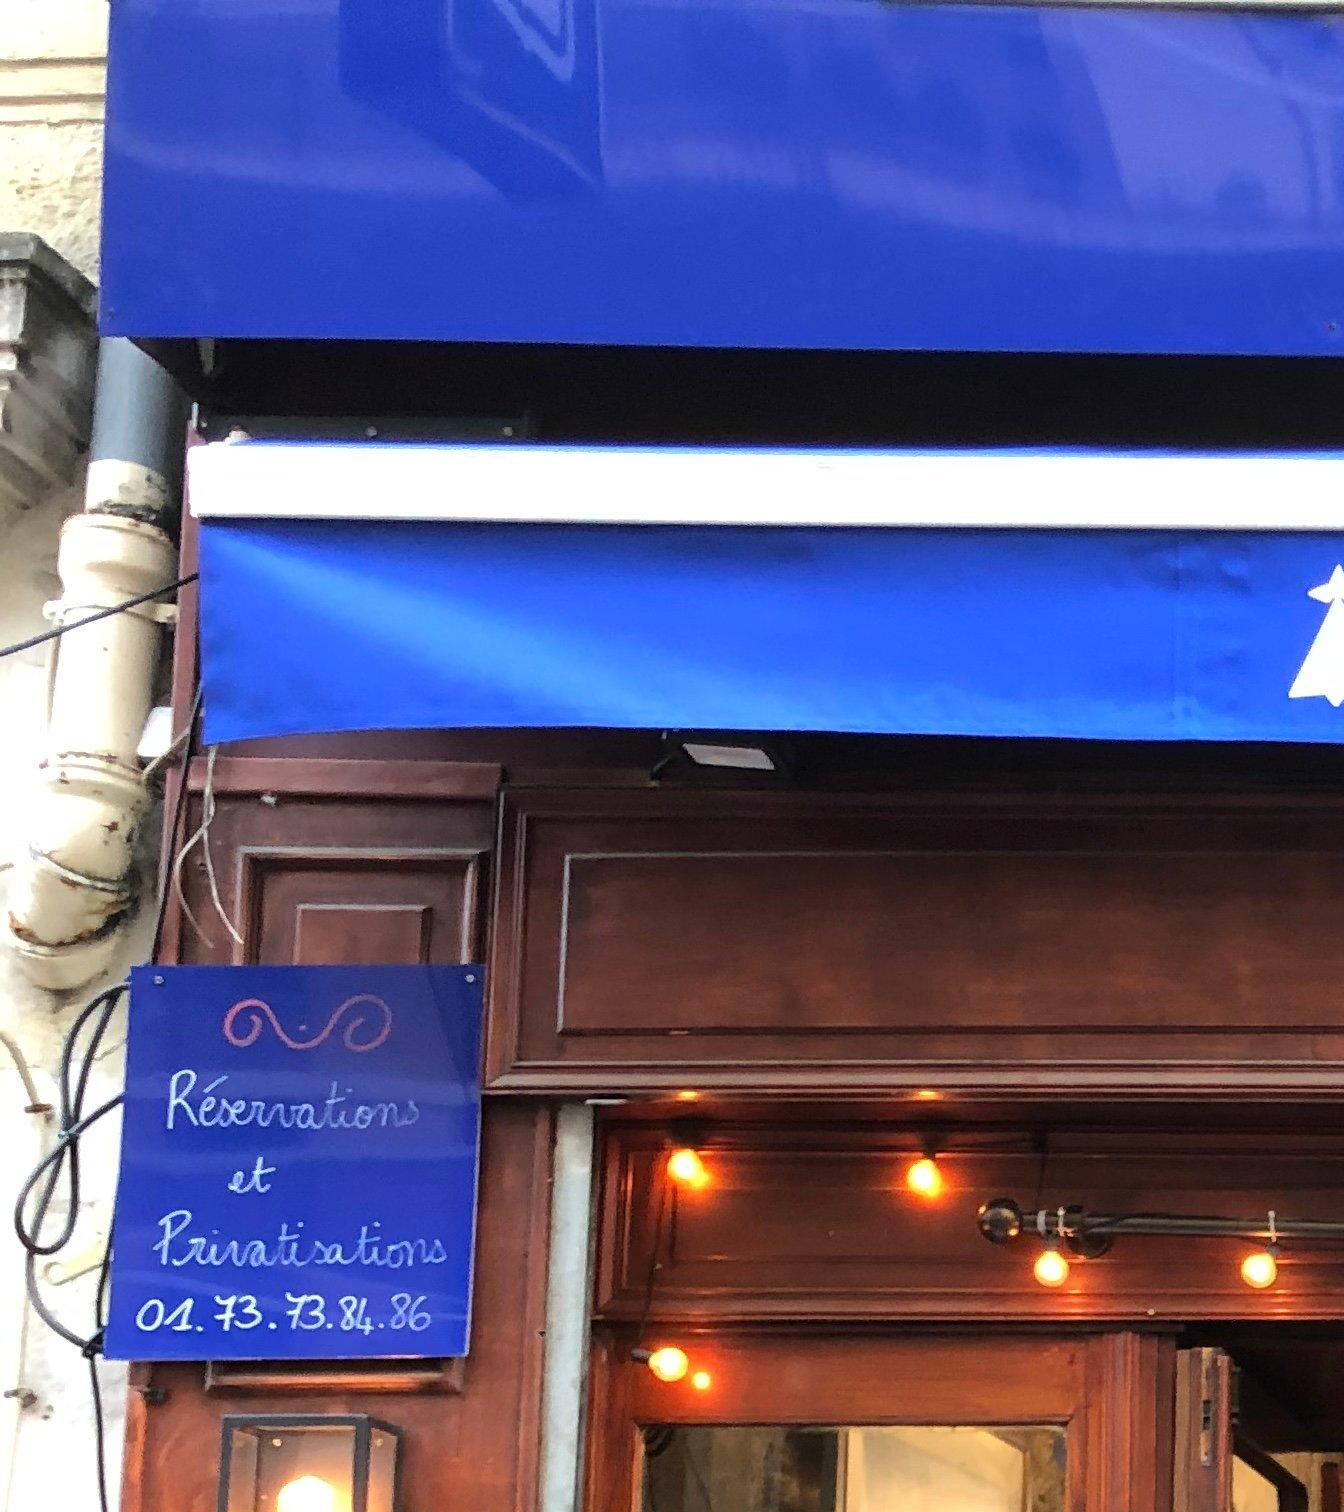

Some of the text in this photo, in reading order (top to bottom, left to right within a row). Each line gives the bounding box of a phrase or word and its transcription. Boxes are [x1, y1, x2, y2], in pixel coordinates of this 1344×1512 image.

[167, 1069, 420, 1130] Réservations
[227, 1157, 277, 1193] et
[153, 1210, 447, 1267] Privatisations
[136, 1292, 432, 1335] 01.73.73.84.86
